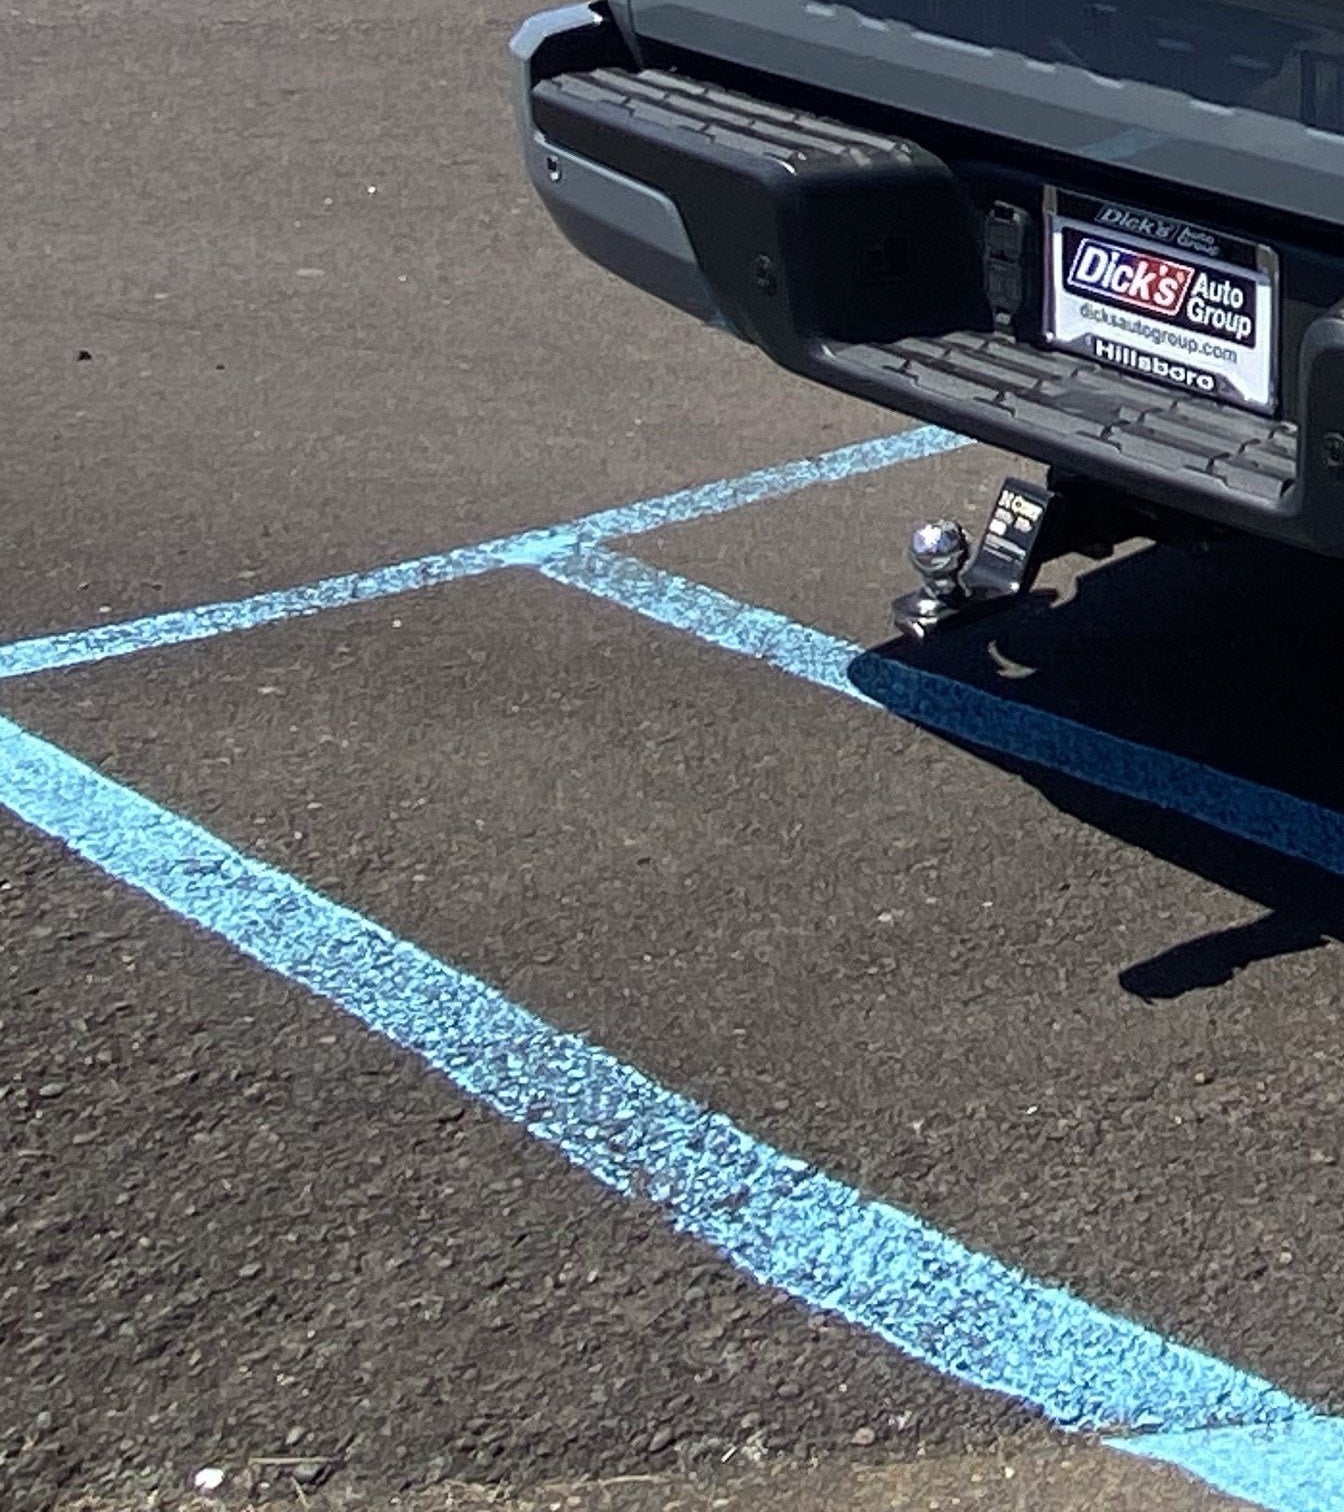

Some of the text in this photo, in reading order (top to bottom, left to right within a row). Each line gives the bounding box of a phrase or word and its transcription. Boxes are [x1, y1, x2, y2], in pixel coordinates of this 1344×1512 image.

[1074, 245, 1180, 308] Dick's
[1192, 272, 1244, 309] Auto
[1079, 302, 1239, 365] dicksautogroup.com
[1186, 298, 1252, 340] Group
[1095, 339, 1216, 391] Hillsboro
